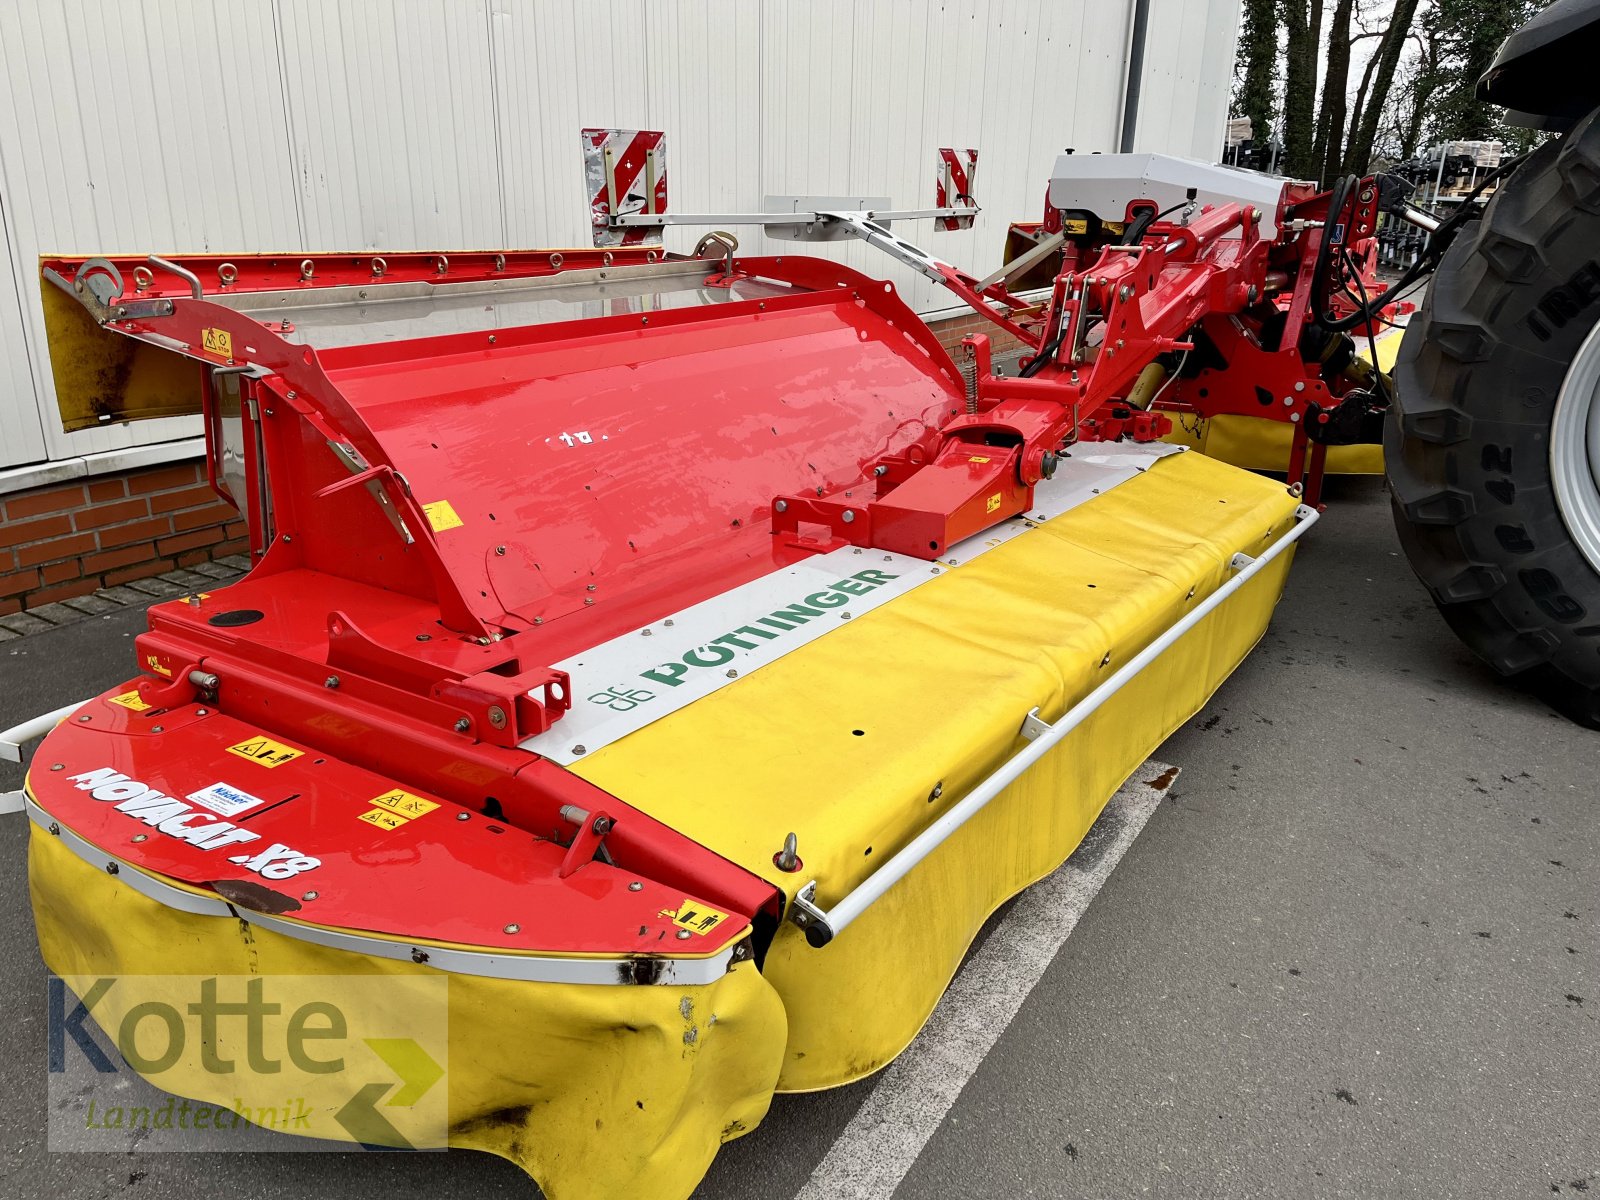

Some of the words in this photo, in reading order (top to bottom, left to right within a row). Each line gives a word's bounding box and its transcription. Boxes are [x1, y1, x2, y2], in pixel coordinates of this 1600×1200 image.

[1480, 443, 1516, 506] 42
[638, 568, 901, 688] PÖTTINGER
[66, 767, 262, 852] NOVACAT
[226, 843, 322, 880] X8
